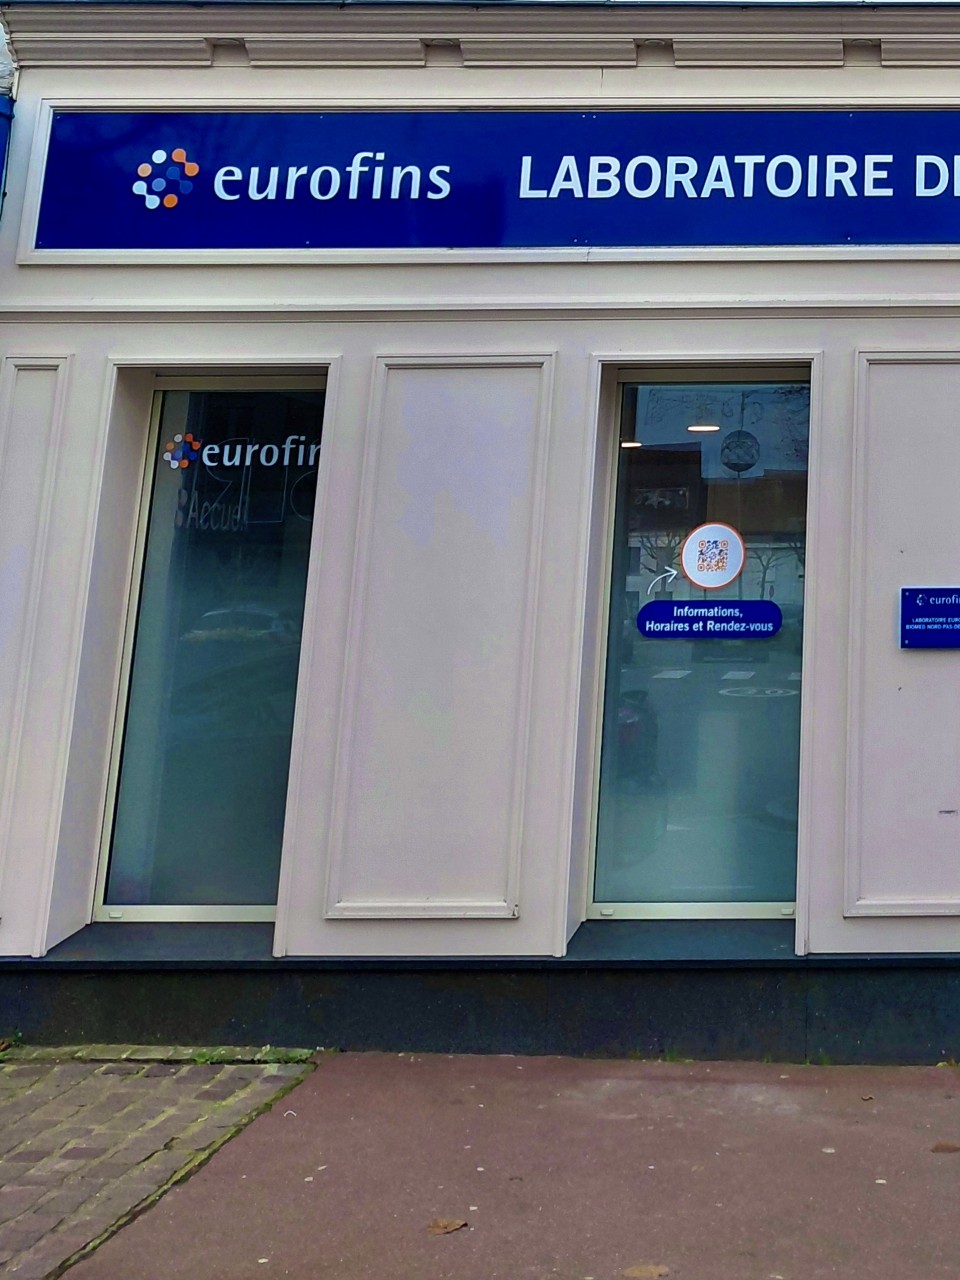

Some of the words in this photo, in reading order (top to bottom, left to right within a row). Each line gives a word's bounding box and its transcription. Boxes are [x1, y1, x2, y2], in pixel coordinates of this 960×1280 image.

[213, 151, 451, 201] eurofins
[518, 154, 894, 198] LABORATOIRE
[645, 620, 690, 632] Horaires
[692, 620, 703, 632] et
[706, 620, 774, 632] Rendez-vous
[673, 605, 744, 619] Informations,
